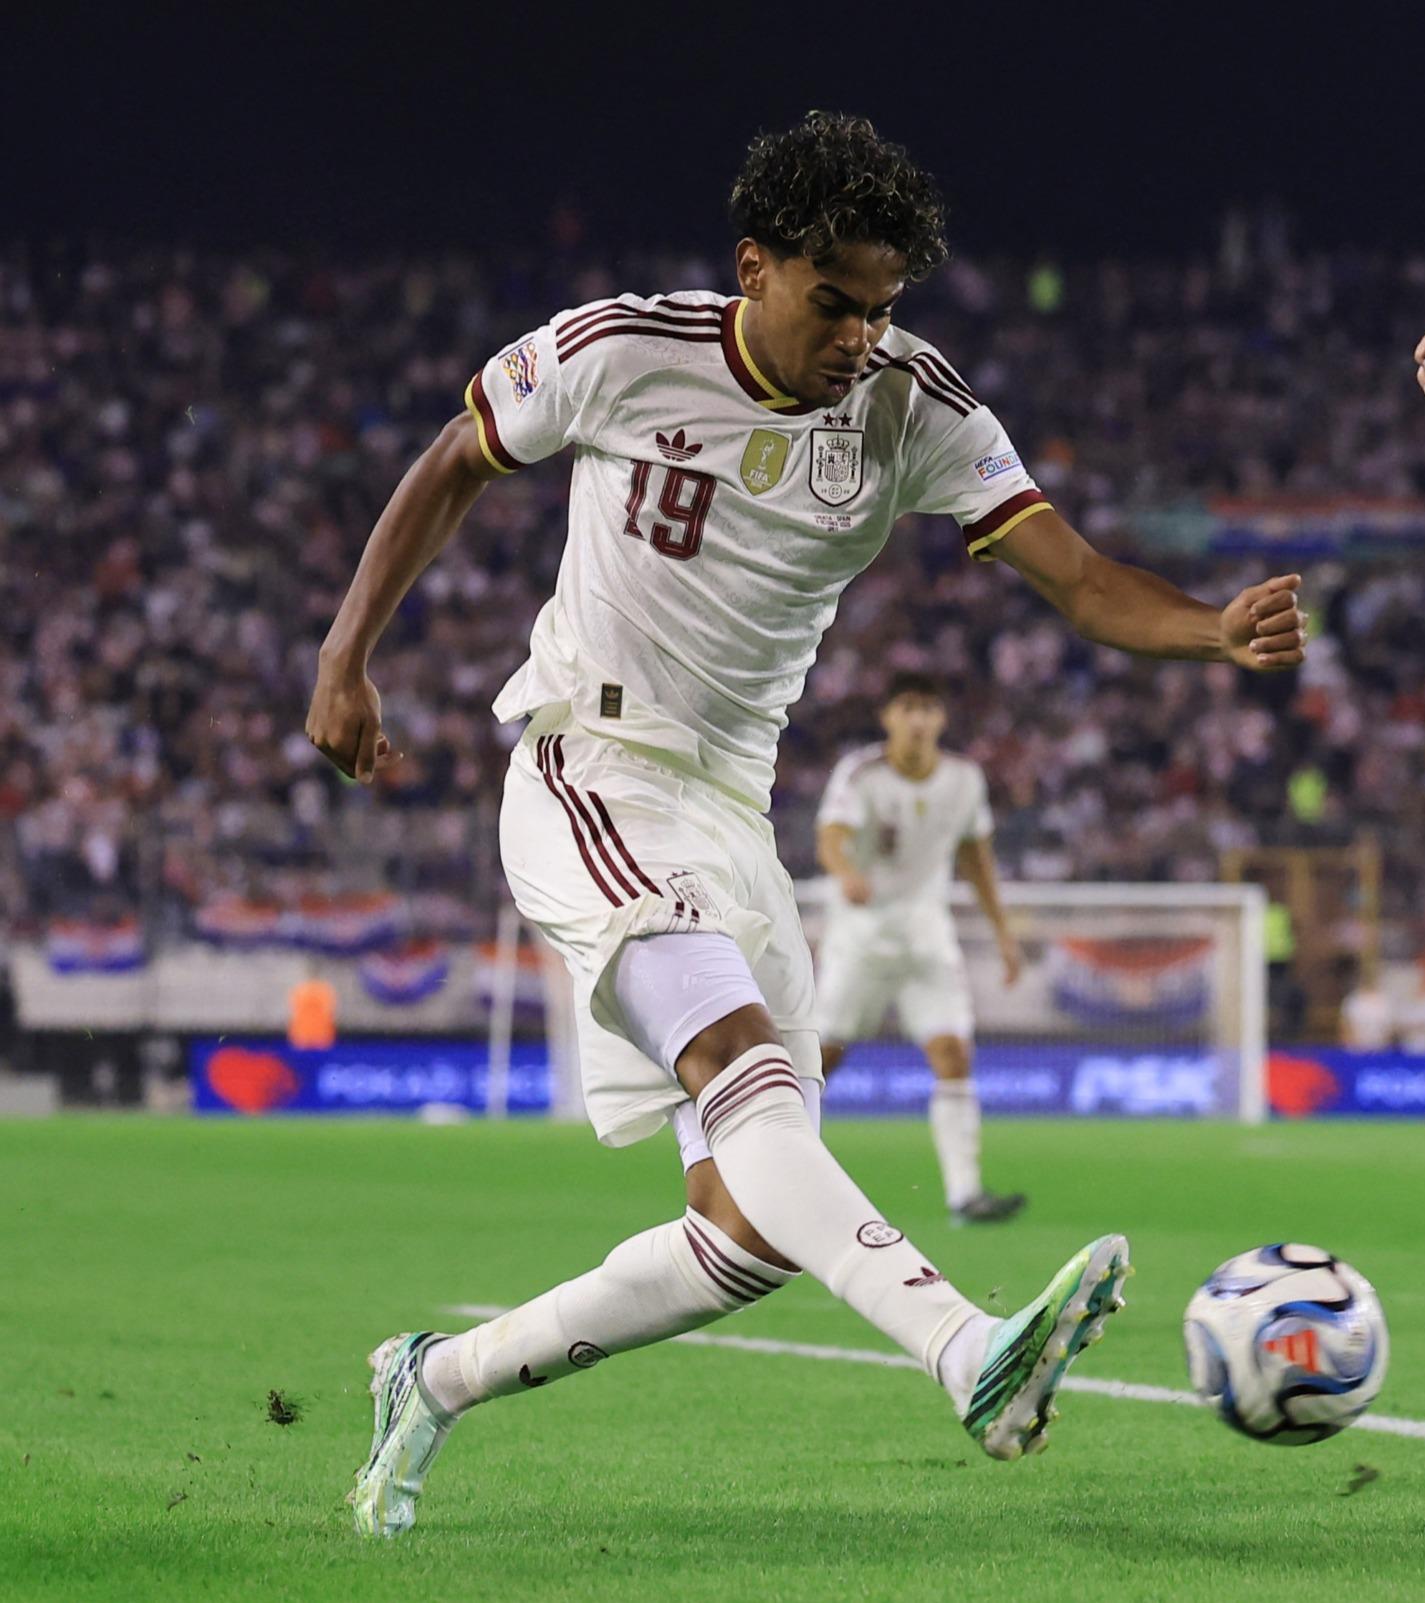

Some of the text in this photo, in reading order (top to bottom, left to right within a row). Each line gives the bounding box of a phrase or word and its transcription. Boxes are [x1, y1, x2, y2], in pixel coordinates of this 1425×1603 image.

[974, 456, 993, 469] UEFA
[749, 469, 769, 482] FIFA
[623, 458, 717, 561] 19
